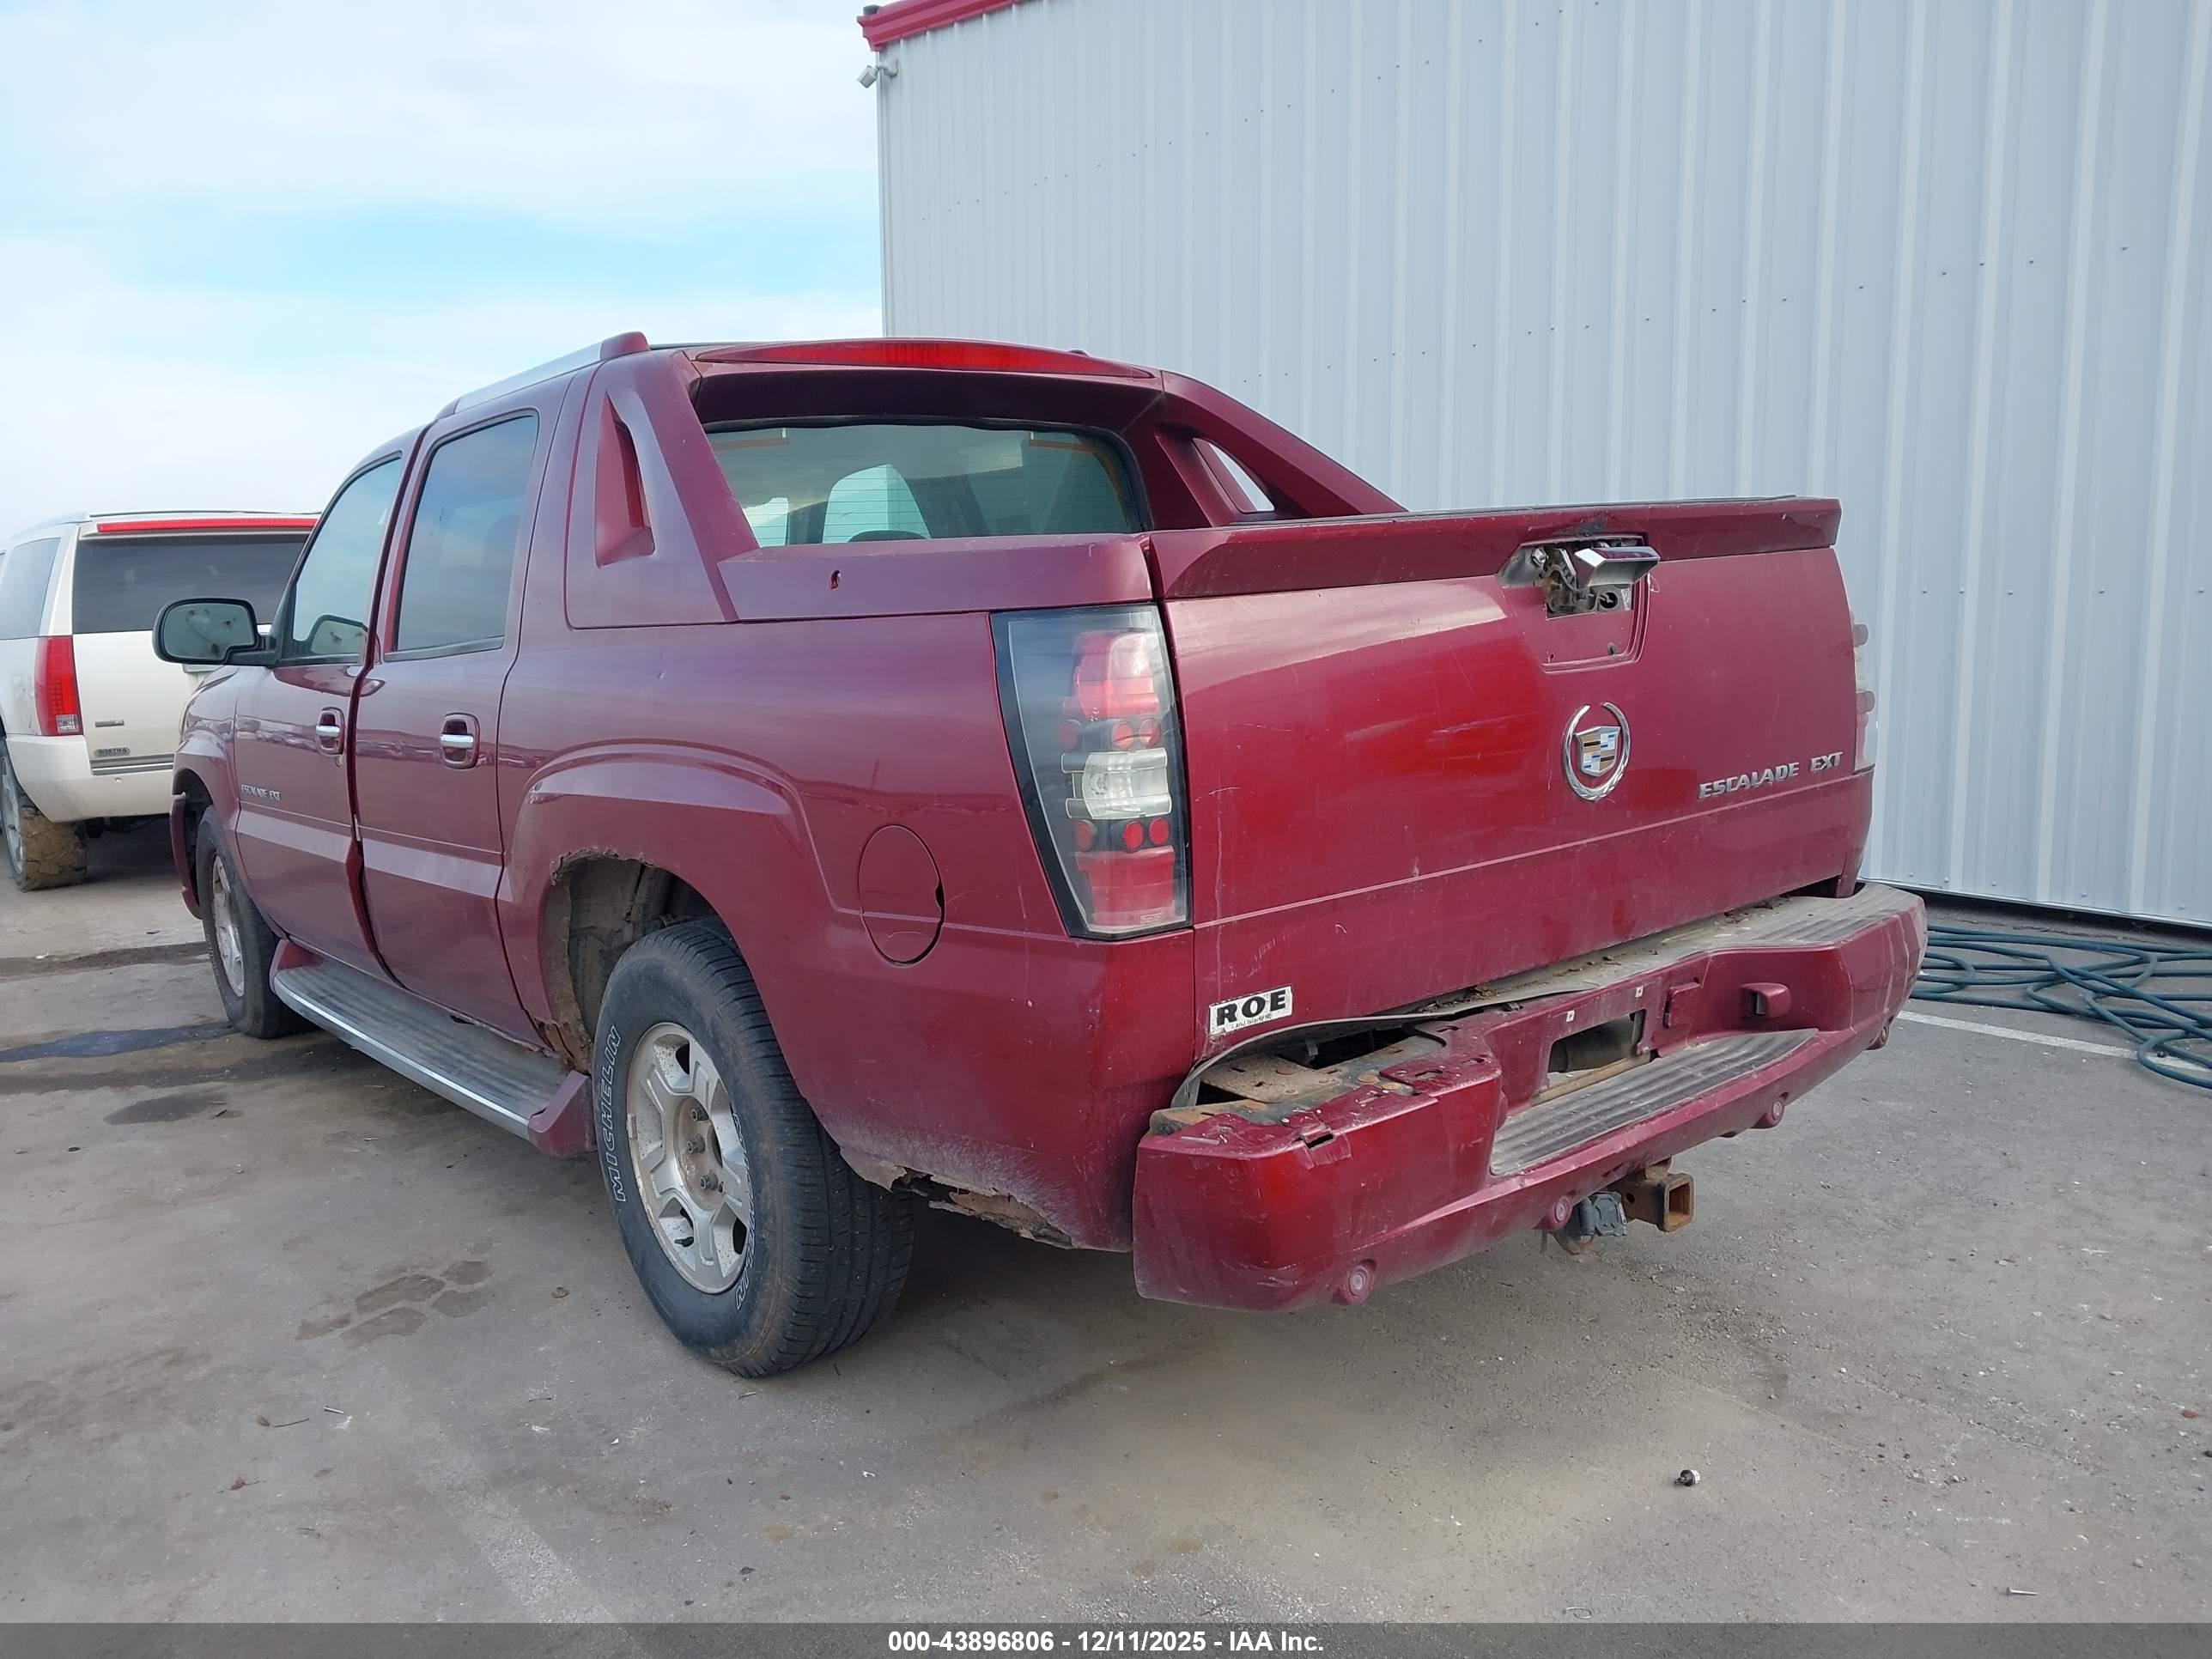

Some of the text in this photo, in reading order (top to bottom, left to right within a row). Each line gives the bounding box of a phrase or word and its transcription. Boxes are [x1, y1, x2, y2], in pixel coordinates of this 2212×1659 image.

[1698, 751, 1844, 800] ESCALADE EXT
[1217, 989, 1286, 1026] ROE
[602, 1025, 626, 1202] MICHELIN
